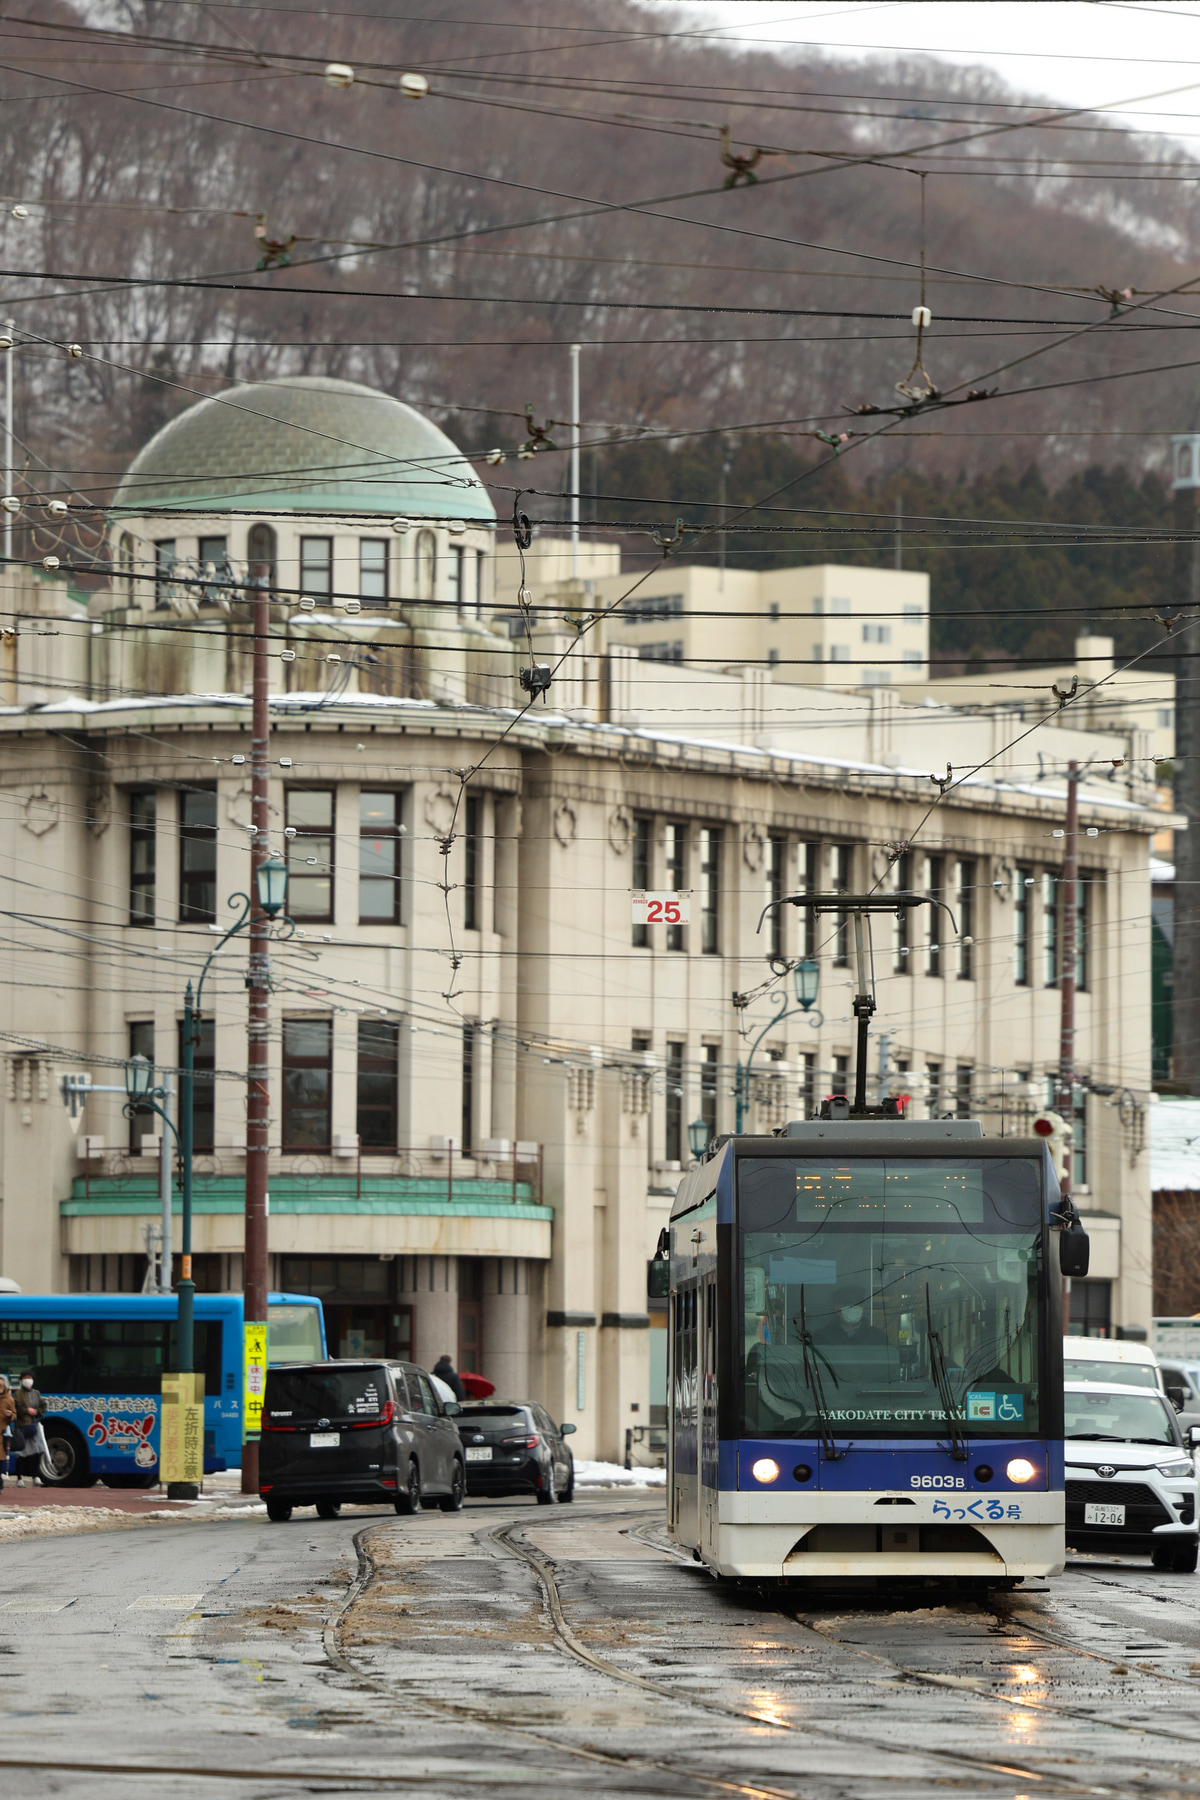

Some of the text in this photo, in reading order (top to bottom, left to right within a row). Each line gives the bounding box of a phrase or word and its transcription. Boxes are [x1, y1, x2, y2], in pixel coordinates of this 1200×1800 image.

[647, 900, 681, 923] 25
[42, 1396, 157, 1413] 館タナベ食品株式会社
[213, 1400, 239, 1409] バス
[894, 1409, 927, 1420] CITY
[928, 1409, 967, 1420] TRAM
[165, 1407, 179, 1479] 歩行者あり
[184, 1406, 199, 1479] 左折時注意
[910, 1475, 965, 1488] 9603B
[932, 1499, 1022, 1520] らっくる号
[1095, 1512, 1123, 1524] 12-06
